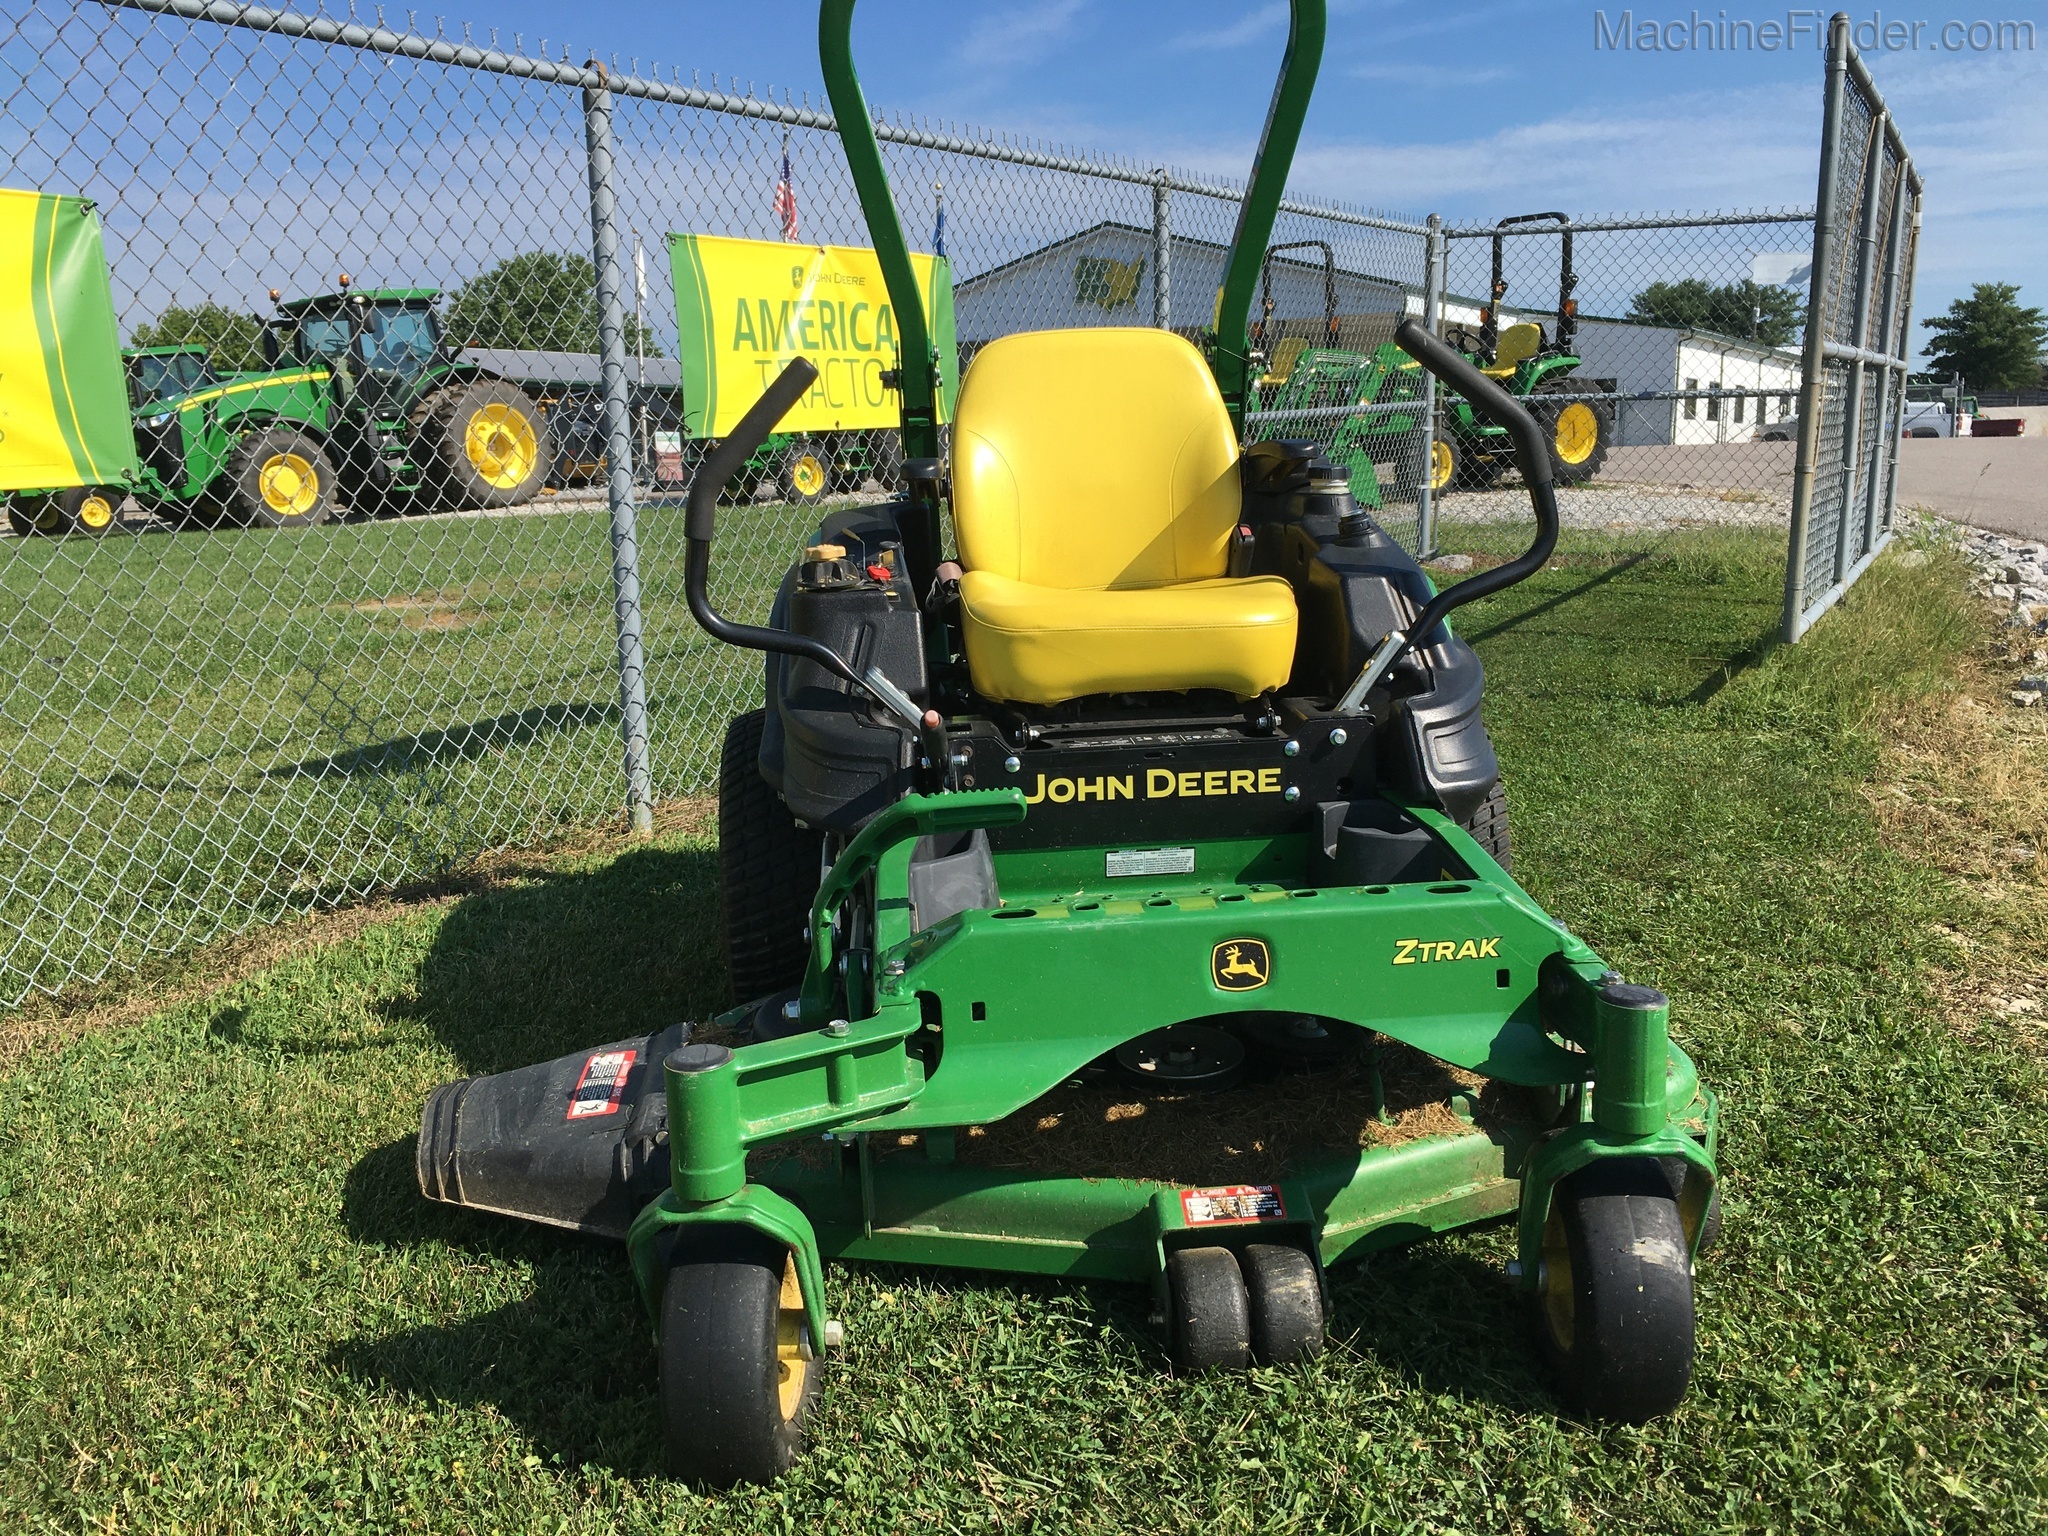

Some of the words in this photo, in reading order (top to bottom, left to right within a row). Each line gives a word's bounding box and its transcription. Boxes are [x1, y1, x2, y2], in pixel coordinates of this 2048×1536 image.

[808, 272, 832, 284] JOHN
[834, 272, 866, 286] DEERE
[1026, 774, 1134, 804] JOHN
[1146, 768, 1281, 798] DEERE
[1392, 936, 1503, 966] ZTRAK
